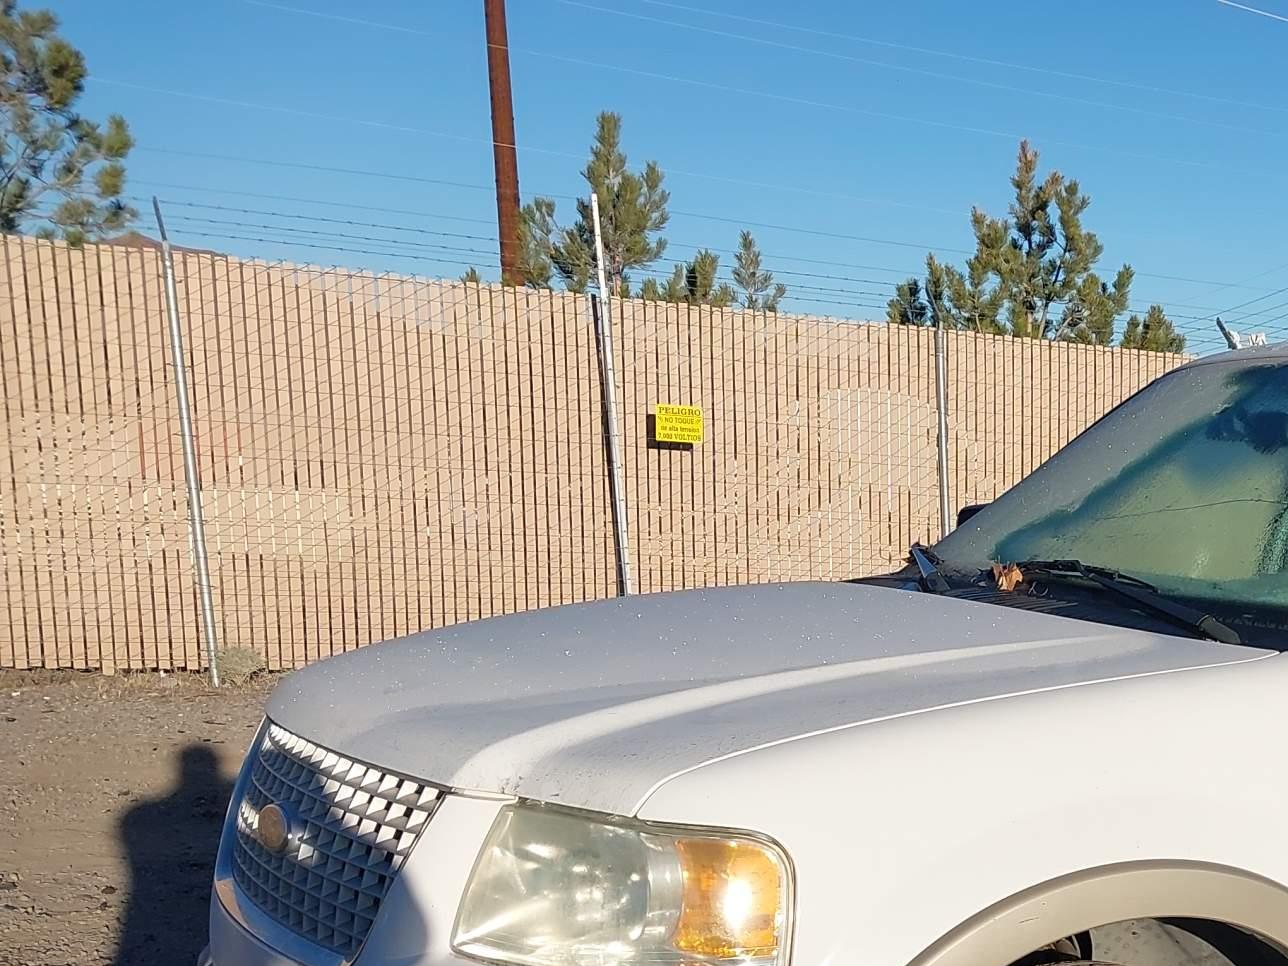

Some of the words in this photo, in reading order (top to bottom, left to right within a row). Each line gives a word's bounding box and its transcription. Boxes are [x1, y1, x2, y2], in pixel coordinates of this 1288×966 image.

[658, 406, 701, 417] PELIGRO
[664, 416, 673, 424] NO
[674, 417, 695, 425] TOQUE
